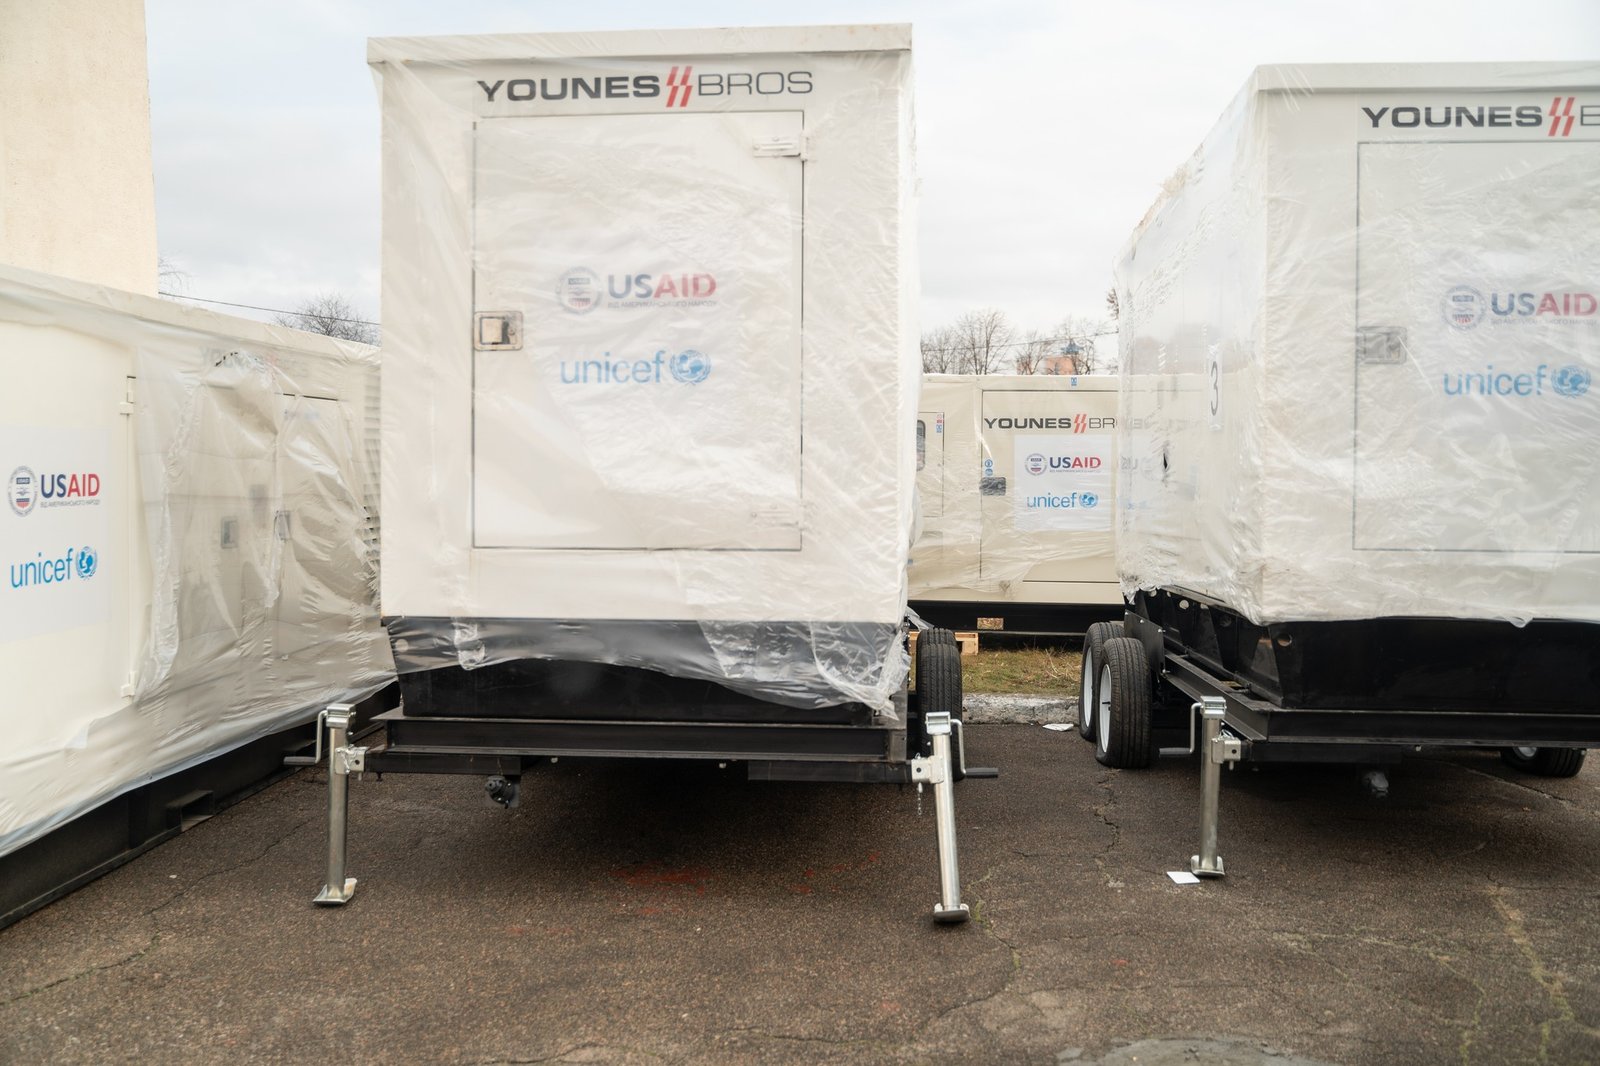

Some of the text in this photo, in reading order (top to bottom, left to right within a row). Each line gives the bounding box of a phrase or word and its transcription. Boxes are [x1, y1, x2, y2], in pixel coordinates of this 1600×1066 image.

[477, 71, 813, 101] YOUNES BROS
[1362, 105, 1543, 128] YOUNES
[608, 274, 717, 299] USAID
[1491, 293, 1598, 317] USAID
[560, 350, 665, 386] unicef
[1211, 361, 1219, 416] 3
[1443, 365, 1547, 397] unicef
[984, 418, 1118, 429] YOUNES BR
[1049, 457, 1102, 469] USAID
[41, 473, 100, 498] USAID
[1027, 492, 1078, 508] unicef
[11, 548, 73, 588] unicef
